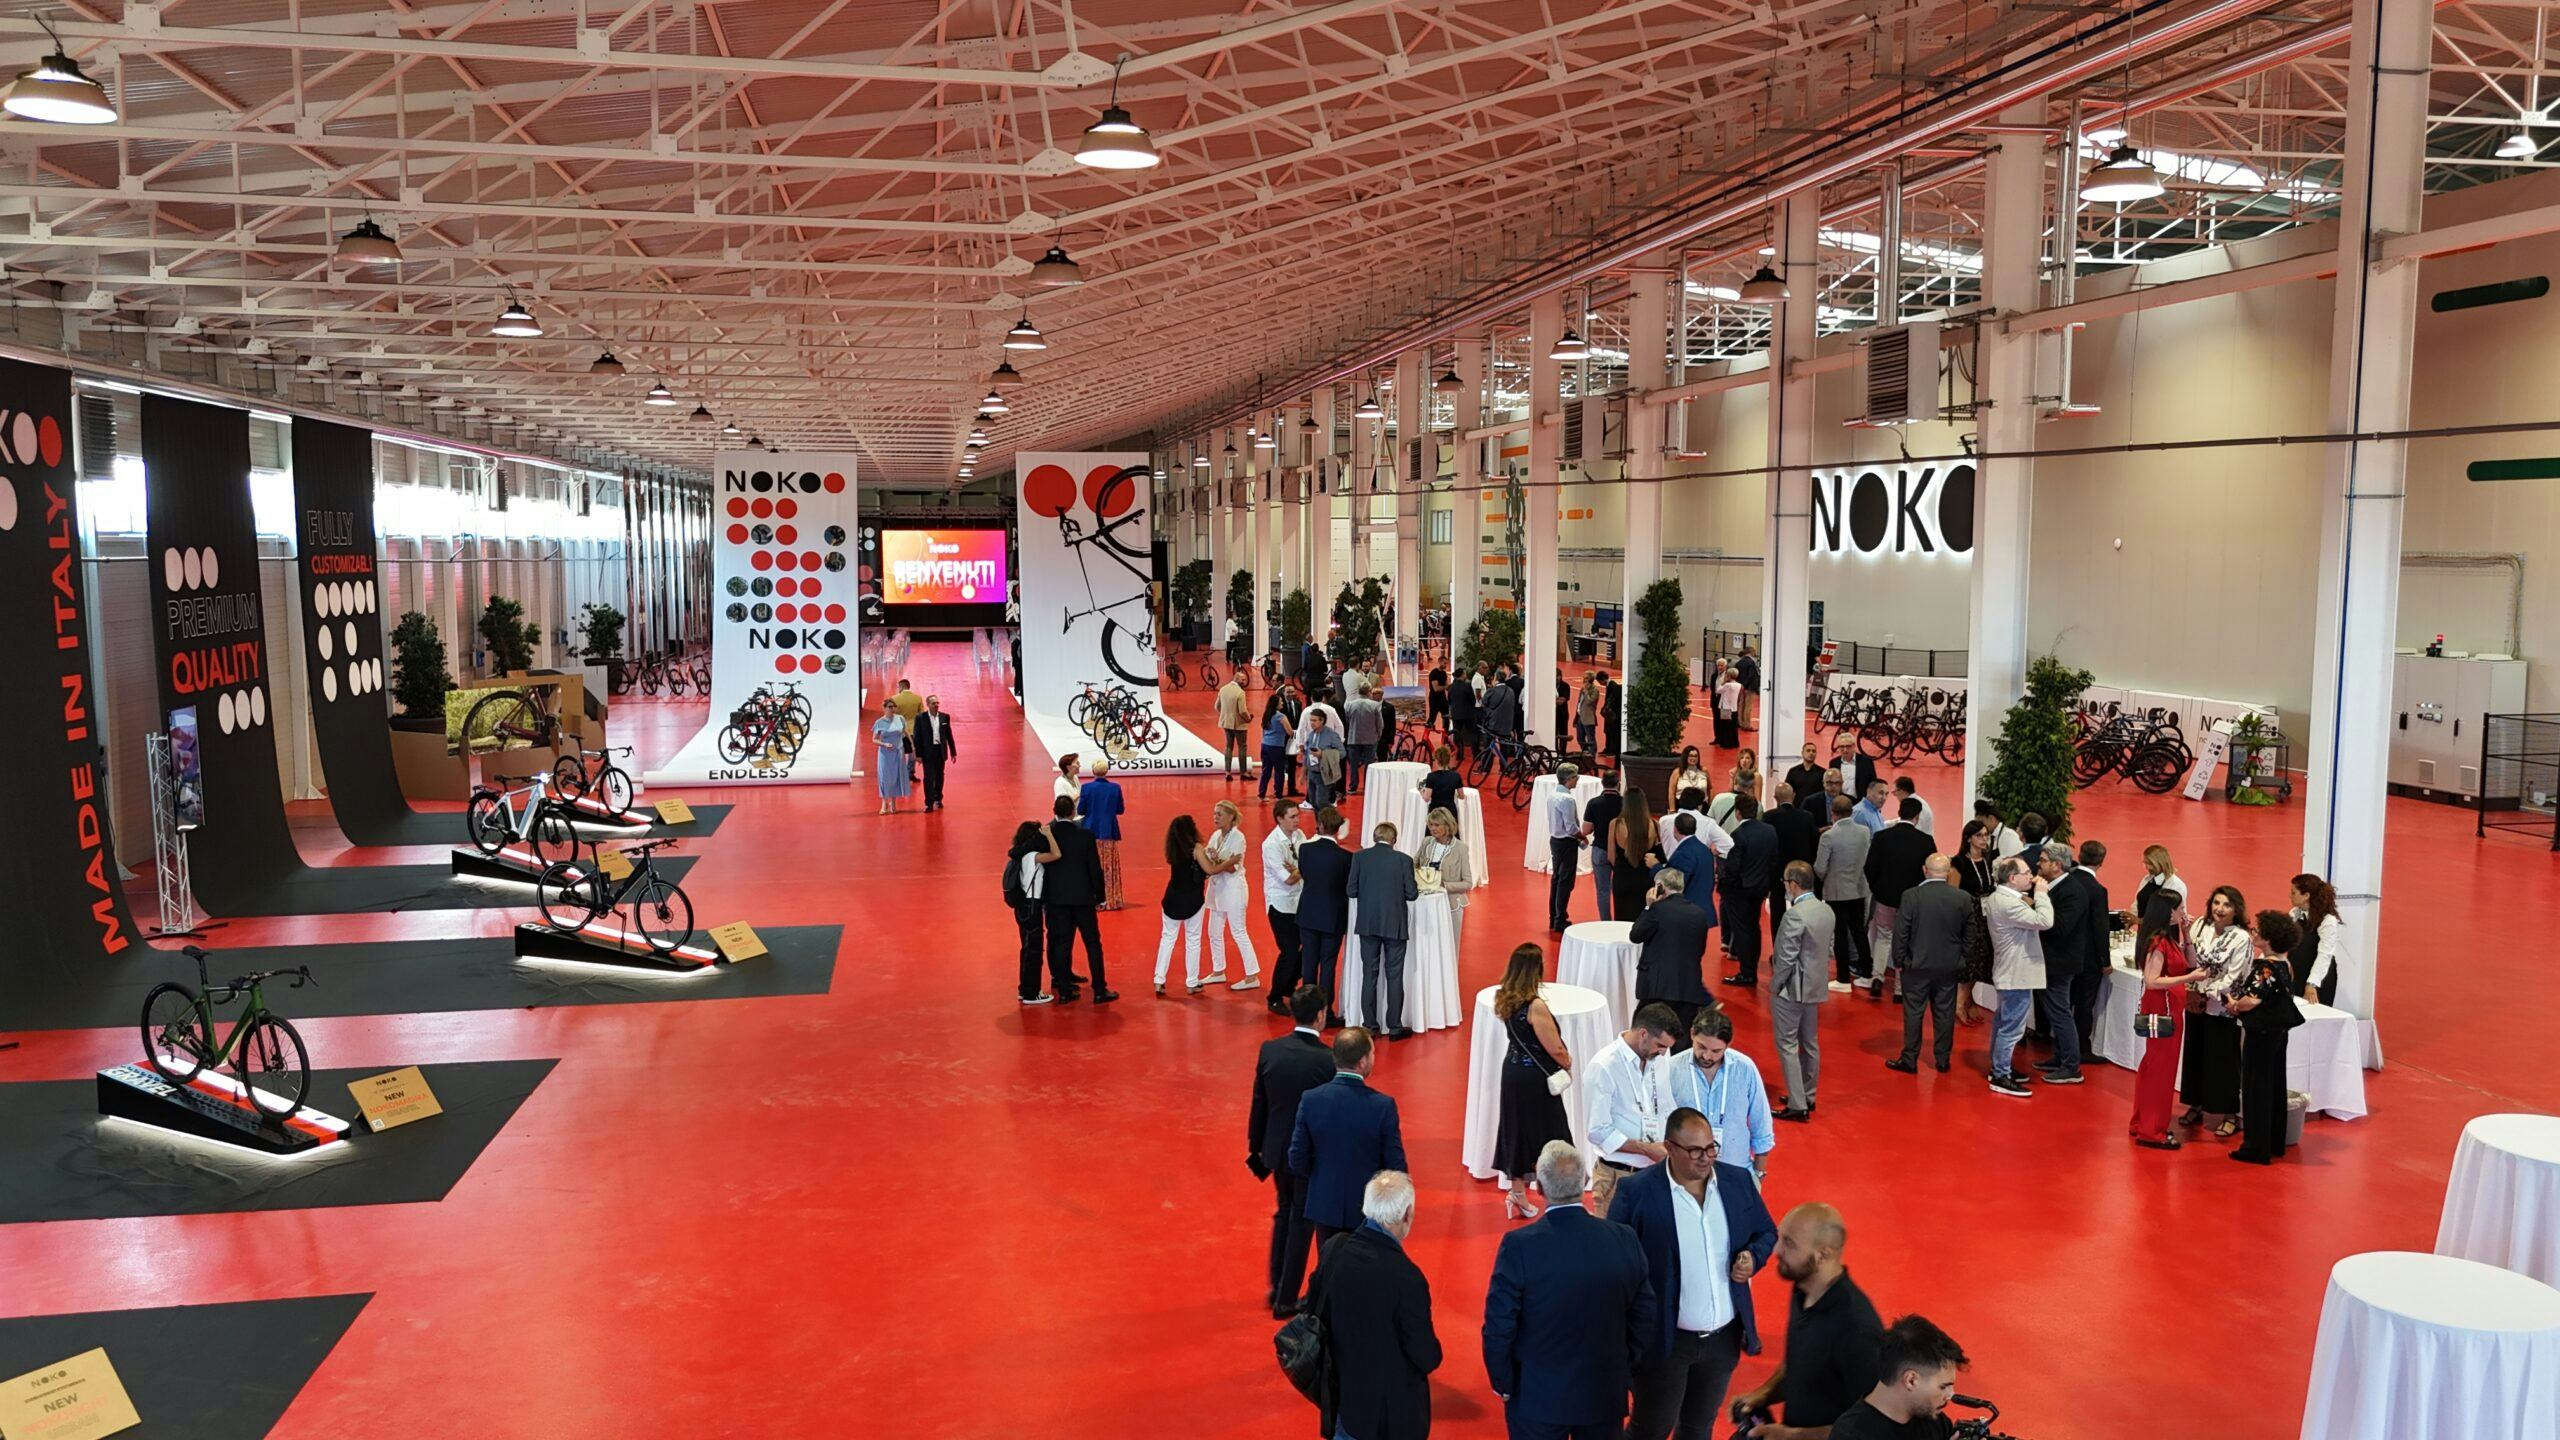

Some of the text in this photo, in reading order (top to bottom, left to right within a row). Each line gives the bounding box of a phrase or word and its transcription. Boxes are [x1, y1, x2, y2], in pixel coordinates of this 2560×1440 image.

[725, 470, 822, 494] NOKO
[1809, 464, 1976, 553] NOKO
[307, 510, 354, 546] FULLY
[167, 592, 258, 640] PREMIUM
[749, 628, 846, 650] NOKO
[172, 641, 259, 694] QUALITY
[43, 481, 129, 955] MADE IN ITALY
[708, 769, 789, 780] ENDLESS
[1107, 758, 1213, 771] POSSIBILITIES
[384, 1091, 405, 1102] NEW
[31, 1370, 67, 1389] NOKO
[43, 1393, 78, 1413] NEW
